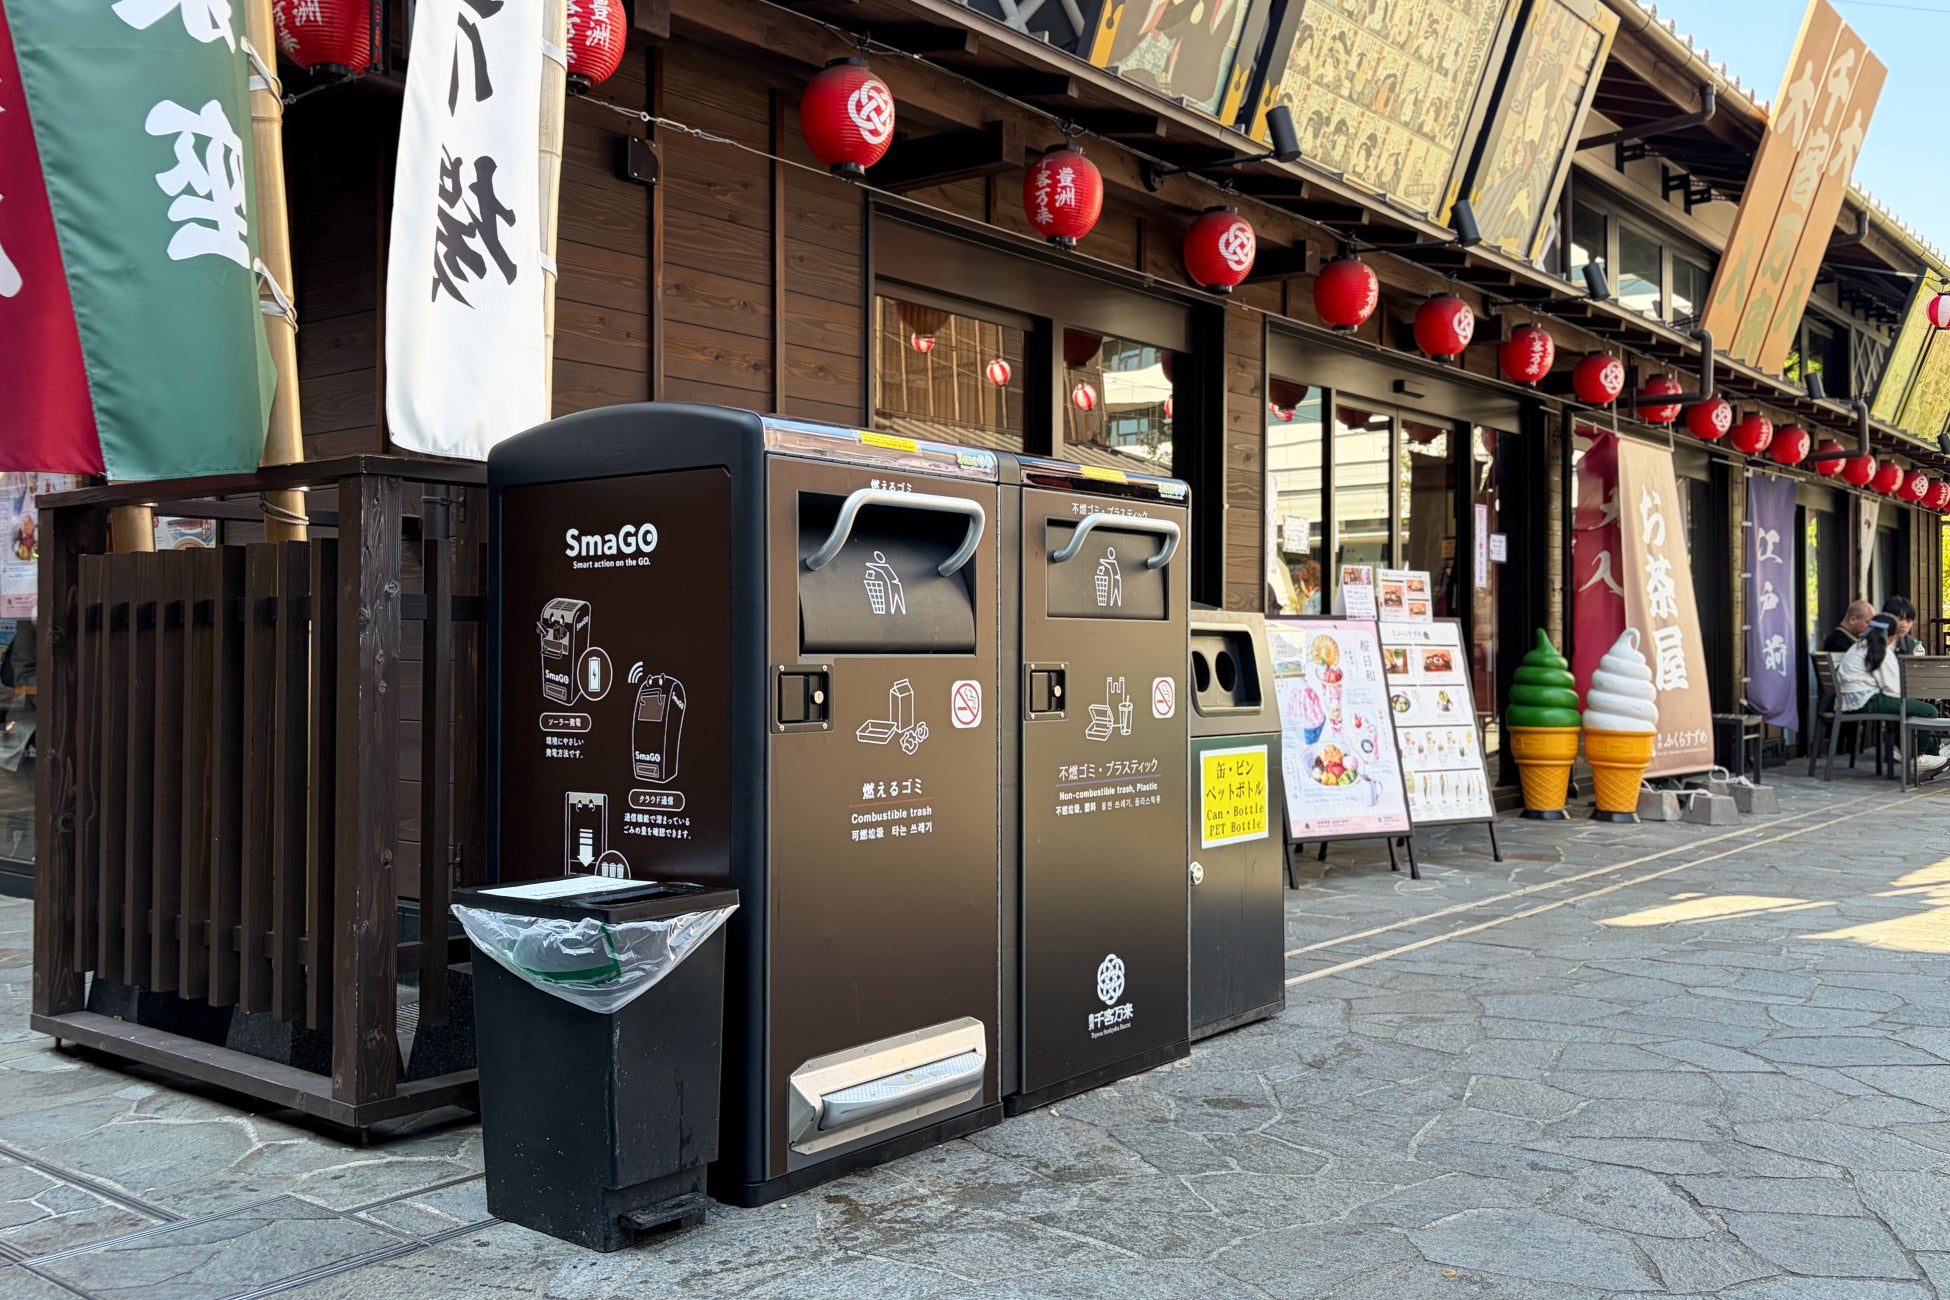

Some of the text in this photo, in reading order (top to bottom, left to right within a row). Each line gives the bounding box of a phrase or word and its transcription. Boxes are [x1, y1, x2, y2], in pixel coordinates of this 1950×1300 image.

[1055, 167, 1075, 208] 豊洲
[565, 523, 658, 557] SmaGO
[573, 561, 593, 569] Smart
[594, 559, 614, 568] action
[625, 558, 637, 566] the
[638, 557, 651, 566] GO.
[1757, 527, 1787, 677] 江戸前
[545, 669, 569, 685] SmaGO
[548, 717, 581, 728] ソーラー発電
[545, 736, 584, 746] 環境にやさしい
[545, 748, 584, 759] 発電方法です。
[635, 751, 661, 762] SmaGO
[1059, 758, 1158, 781] 不燃ゴミ・プラスティック
[862, 778, 922, 800] 燃えるゴミ
[1059, 781, 1158, 801] Non-combustible trash, Plastic
[1206, 781, 1264, 801] ペットボトル
[639, 794, 674, 806] クラウド通信
[624, 813, 691, 826] 通信機能で溜まっている
[851, 806, 932, 824] Combustible trash
[1207, 809, 1223, 821] Can
[1233, 802, 1264, 817] Bottle
[623, 825, 692, 840] ごみの量を確認できます。
[851, 827, 885, 841] 可燃垃圾
[891, 821, 933, 837] 타는 쓰레기
[1210, 818, 1262, 837] PET Bottle
[1094, 1002, 1134, 1028] 千客万来
